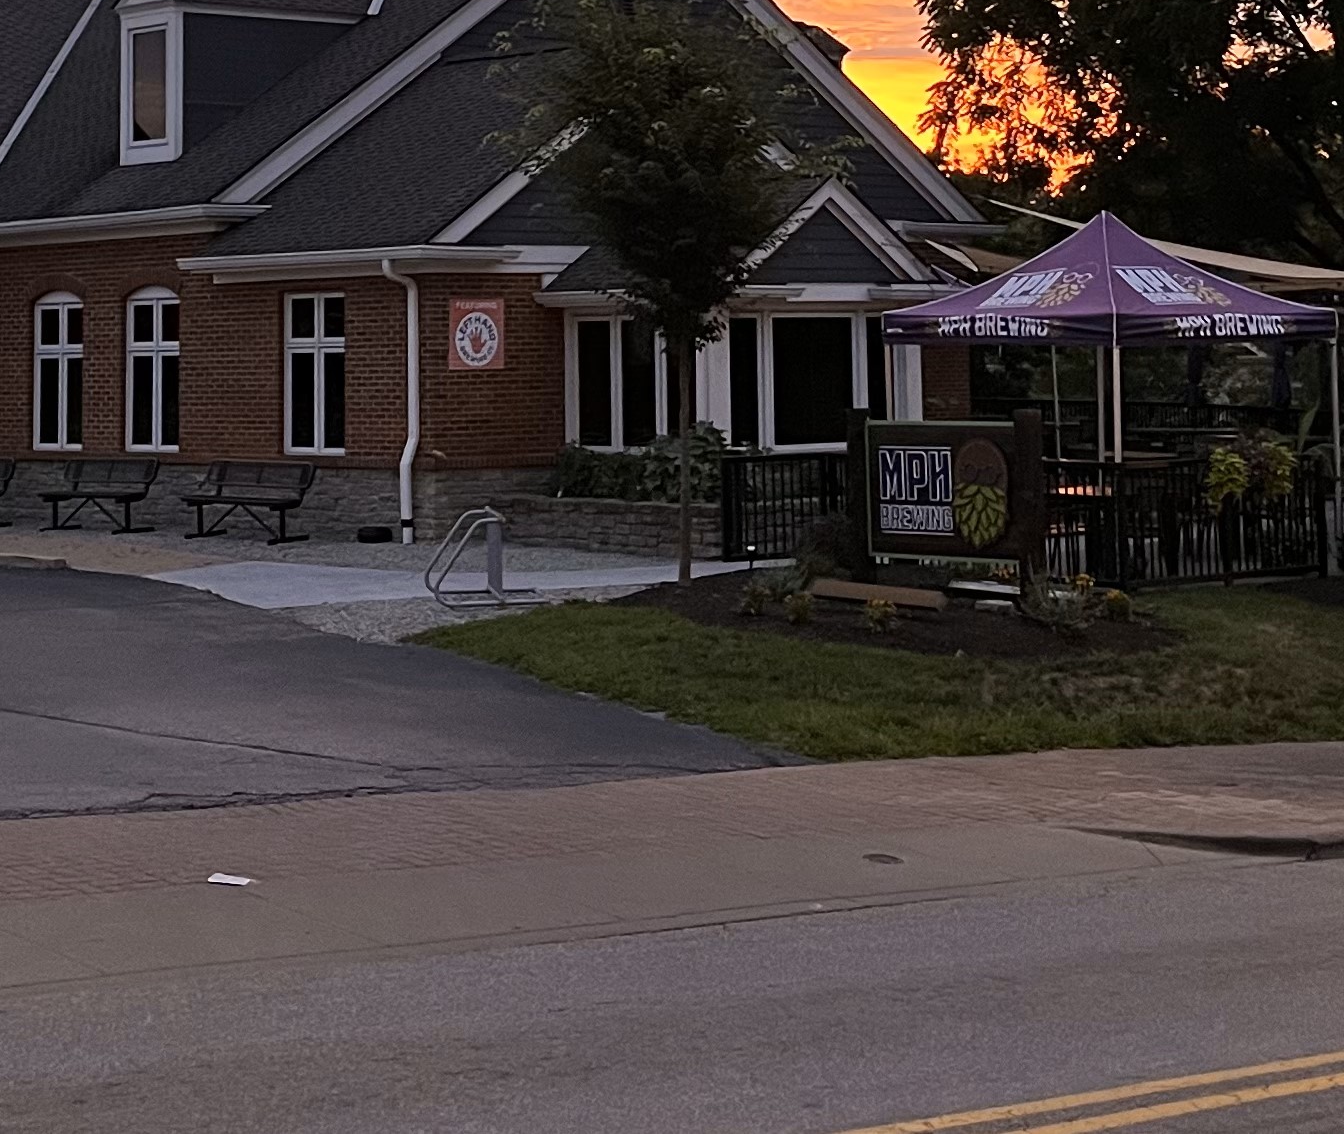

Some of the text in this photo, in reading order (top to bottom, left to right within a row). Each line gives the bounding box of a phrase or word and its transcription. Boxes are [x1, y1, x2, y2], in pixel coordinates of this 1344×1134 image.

[994, 270, 1064, 297] MPH
[1116, 269, 1187, 293] MPH
[457, 315, 496, 341] LEFT HAND
[974, 313, 1050, 337] BREWING
[879, 450, 953, 502] MPH
[880, 504, 954, 531] BREWING
